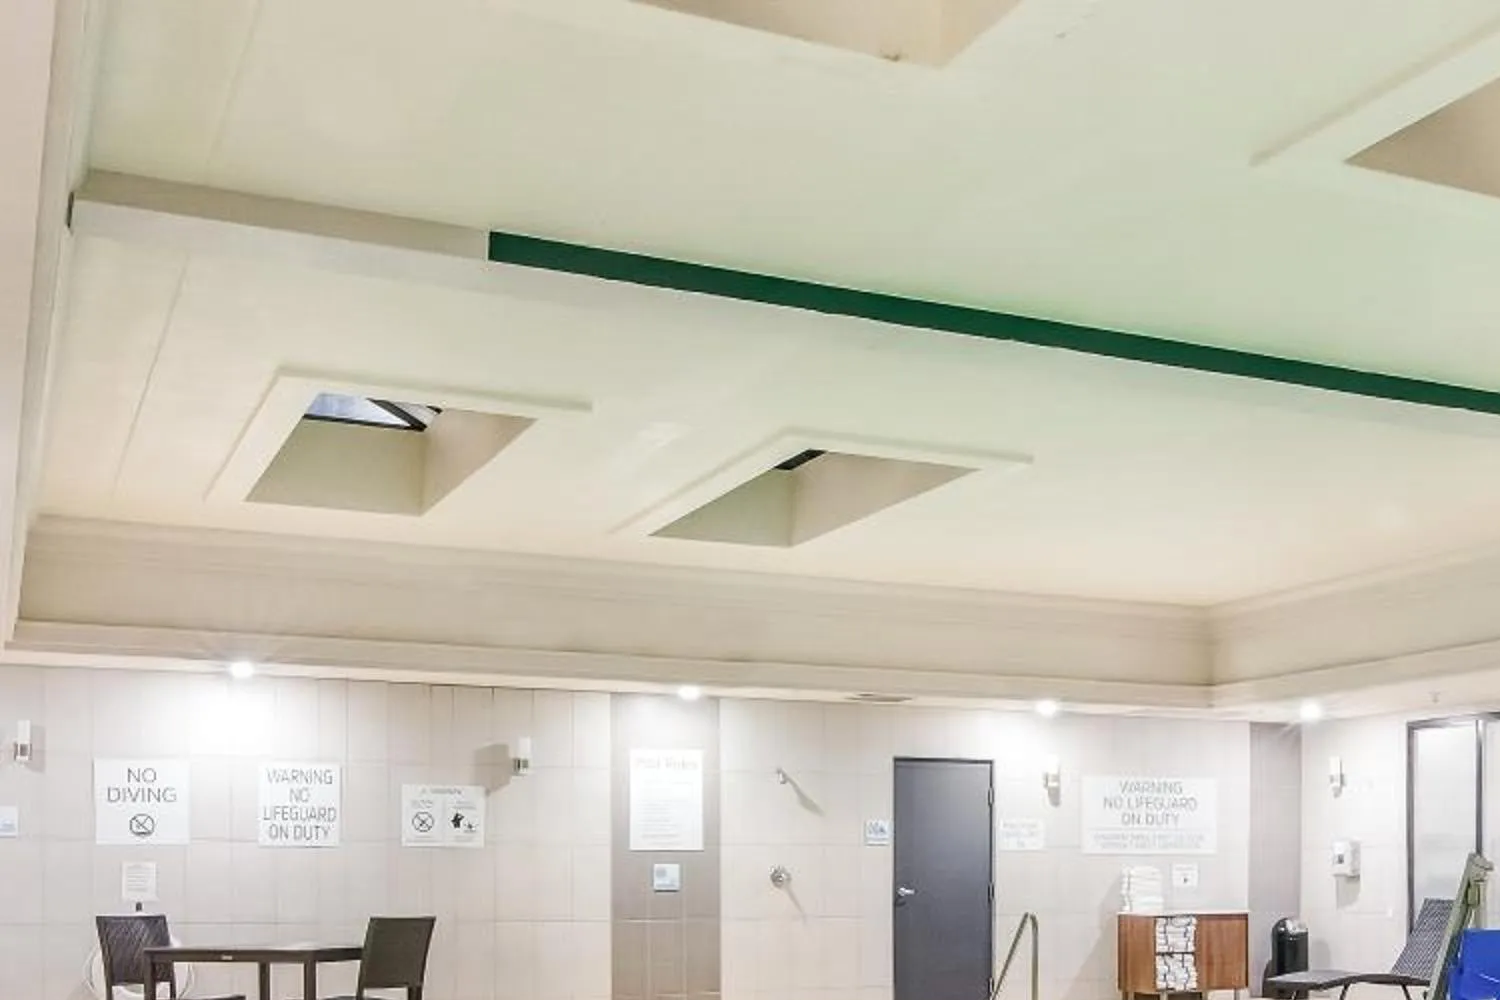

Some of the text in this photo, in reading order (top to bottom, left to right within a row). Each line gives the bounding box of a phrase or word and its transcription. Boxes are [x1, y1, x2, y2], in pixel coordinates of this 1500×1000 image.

[127, 767, 157, 783] NO
[266, 767, 333, 785] WARNING
[107, 786, 177, 803] DIVING
[289, 786, 311, 803] NO
[1119, 780, 1183, 794] WARNING
[1103, 796, 1197, 811] NO LIFEGUARD
[263, 805, 337, 822] LIFEGUARD
[1121, 812, 1179, 826] ON DUTY
[268, 823, 331, 841] ON DUTY
